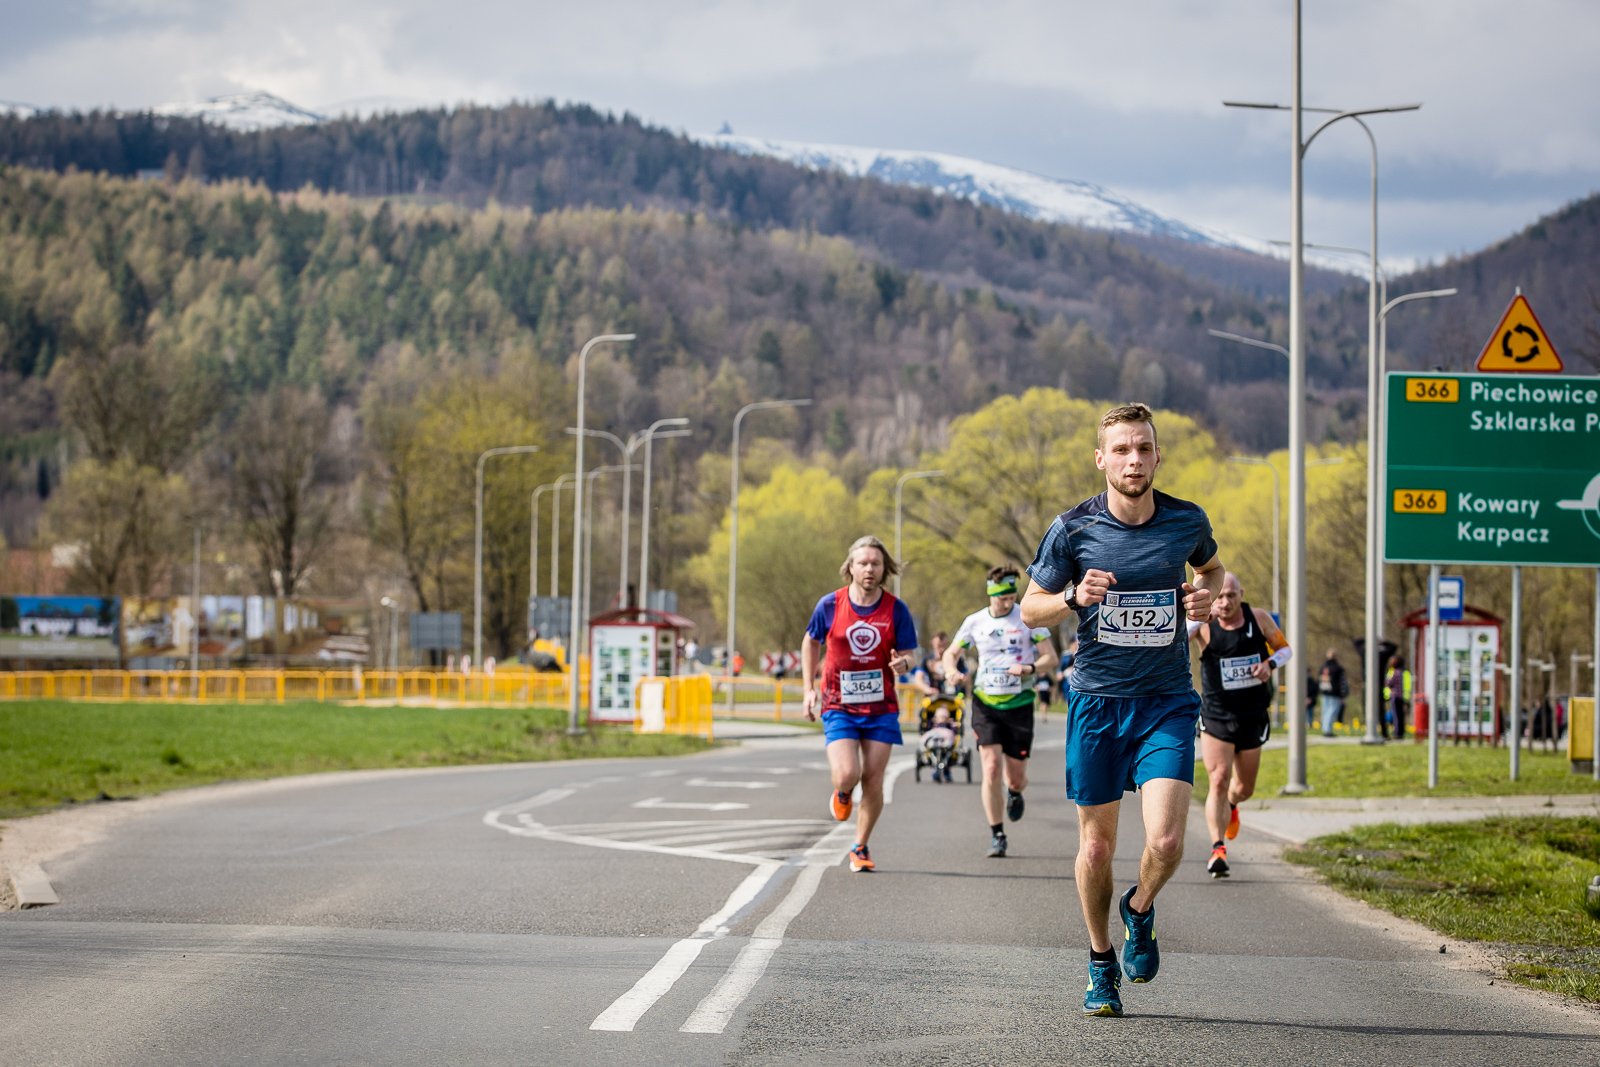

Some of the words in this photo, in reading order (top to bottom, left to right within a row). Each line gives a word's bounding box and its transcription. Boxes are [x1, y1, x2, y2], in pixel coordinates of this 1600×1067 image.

[1415, 382, 1450, 398] 366
[1470, 381, 1598, 404] Piechowice
[1470, 410, 1575, 431] Szklarska
[1586, 412, 1600, 432] P
[1403, 493, 1437, 509] 366
[1458, 492, 1540, 519] Kowary
[1457, 521, 1549, 547] Karpacz
[1119, 609, 1156, 627] 152
[1232, 666, 1253, 678] 834
[852, 681, 873, 692] 364
